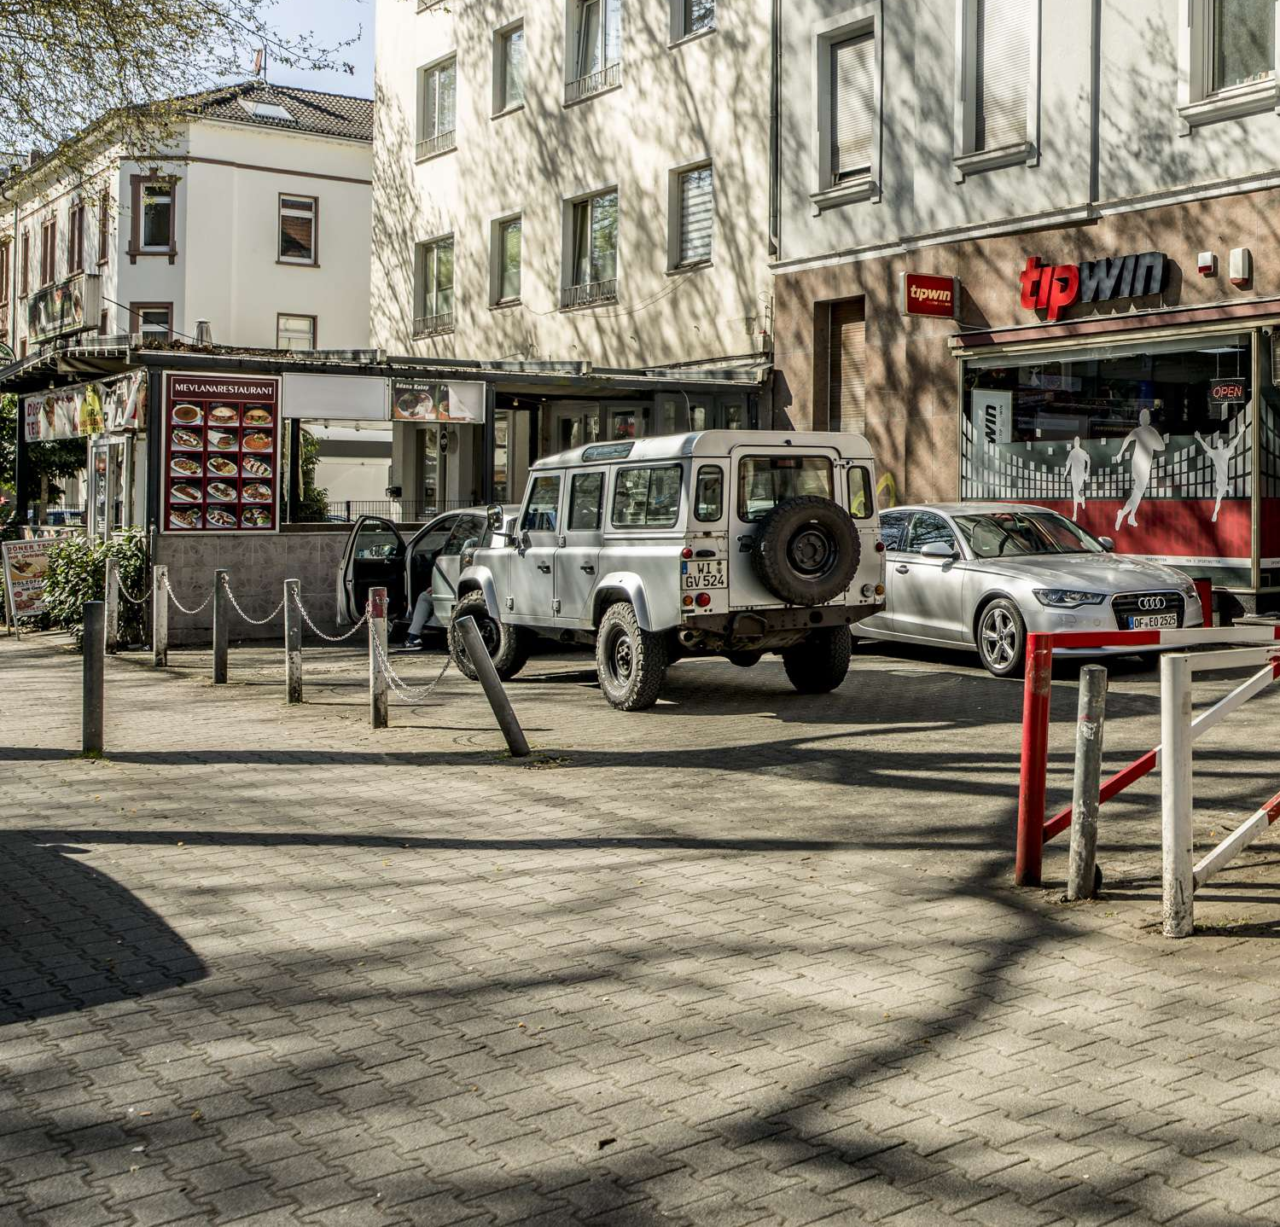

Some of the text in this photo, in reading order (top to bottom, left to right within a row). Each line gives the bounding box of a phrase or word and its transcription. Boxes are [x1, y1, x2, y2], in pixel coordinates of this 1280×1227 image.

[910, 284, 952, 301] tipwin
[1019, 252, 1168, 322] tipwin
[1212, 385, 1242, 398] OPEN
[697, 562, 712, 574] WI
[685, 574, 724, 588] GV 524
[1134, 614, 1176, 628] OF EO 2525
